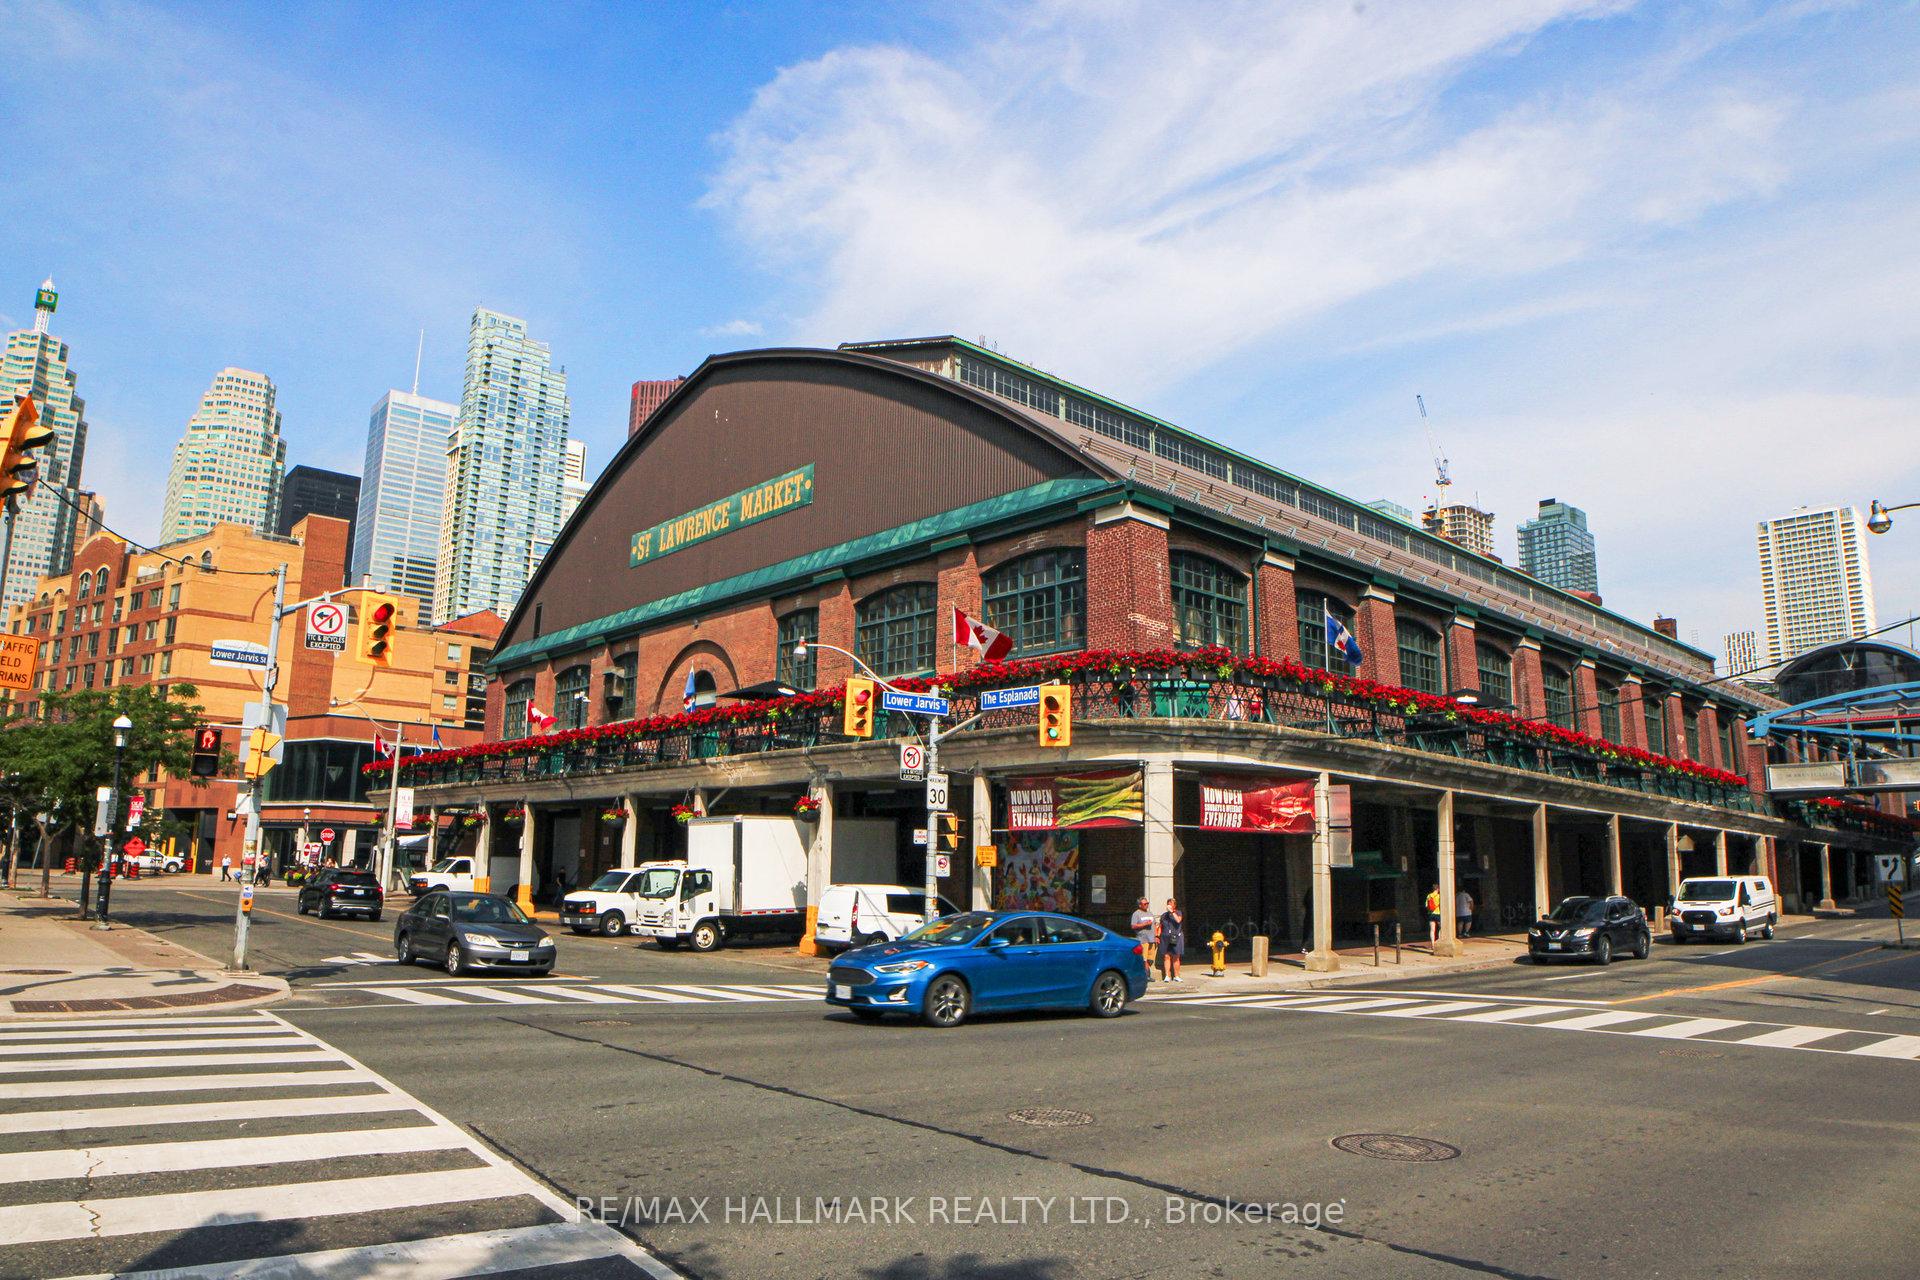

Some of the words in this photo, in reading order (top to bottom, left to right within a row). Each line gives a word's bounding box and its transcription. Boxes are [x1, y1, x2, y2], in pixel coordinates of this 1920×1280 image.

[659, 502, 730, 552] LAWRENCE
[740, 473, 804, 522] MARKET
[310, 642, 341, 650] EXCEPTED
[323, 635, 345, 644] BICYCLES
[212, 648, 236, 660] Lower
[236, 651, 259, 664] Jarvis
[886, 693, 913, 707] Lower
[915, 698, 941, 711] Jarvis
[983, 693, 997, 705] The
[999, 689, 1039, 704] Esplanade
[930, 788, 946, 805] 30
[1010, 790, 1030, 805] NOW
[1031, 789, 1053, 804] OPEN
[1204, 787, 1222, 804] NOW
[1223, 788, 1243, 805] OPEN
[1012, 812, 1053, 827] EVENINGS
[1203, 812, 1242, 828] EVENINGS
